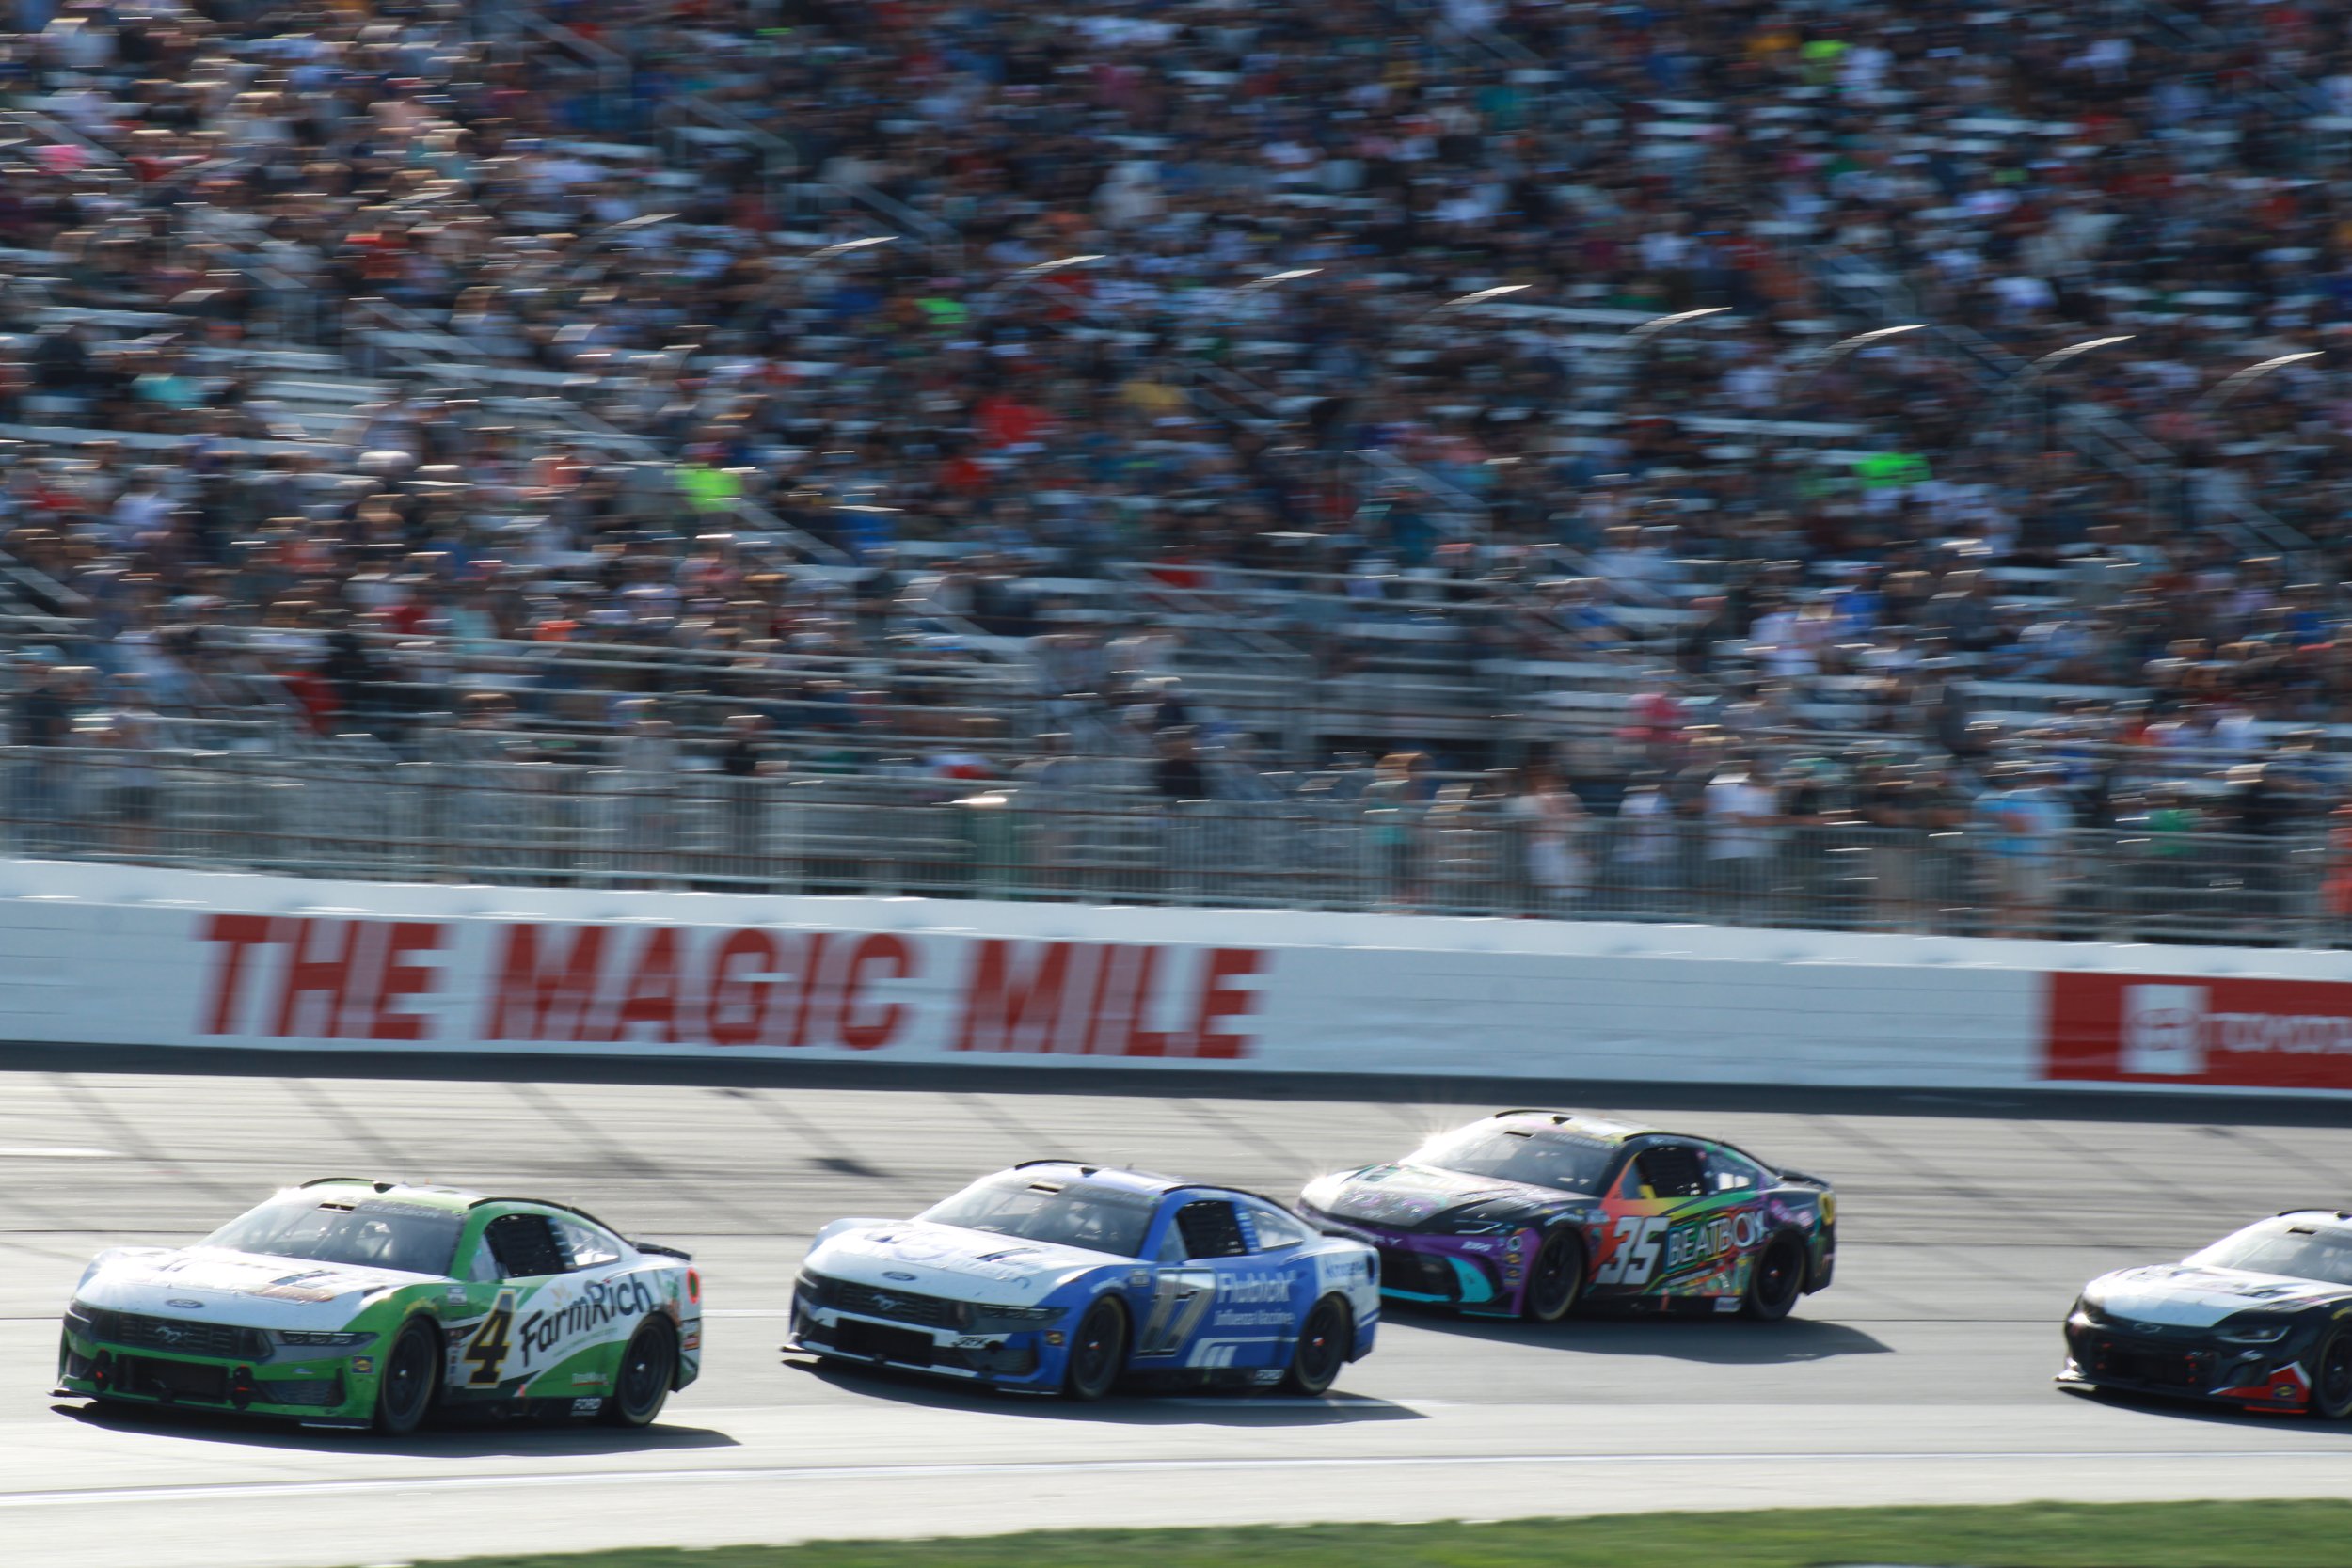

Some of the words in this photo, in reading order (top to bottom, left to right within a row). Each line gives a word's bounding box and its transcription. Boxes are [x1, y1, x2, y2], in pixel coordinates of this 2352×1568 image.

[199, 913, 448, 1040] THE
[484, 922, 925, 1051] MAGIC
[955, 939, 1276, 1060] MILE
[1596, 1216, 1671, 1284] 35
[1666, 1210, 1768, 1268] BEATBOX
[465, 1288, 516, 1389] 4
[1134, 1267, 1217, 1359] 17
[573, 1398, 602, 1410] FORD
